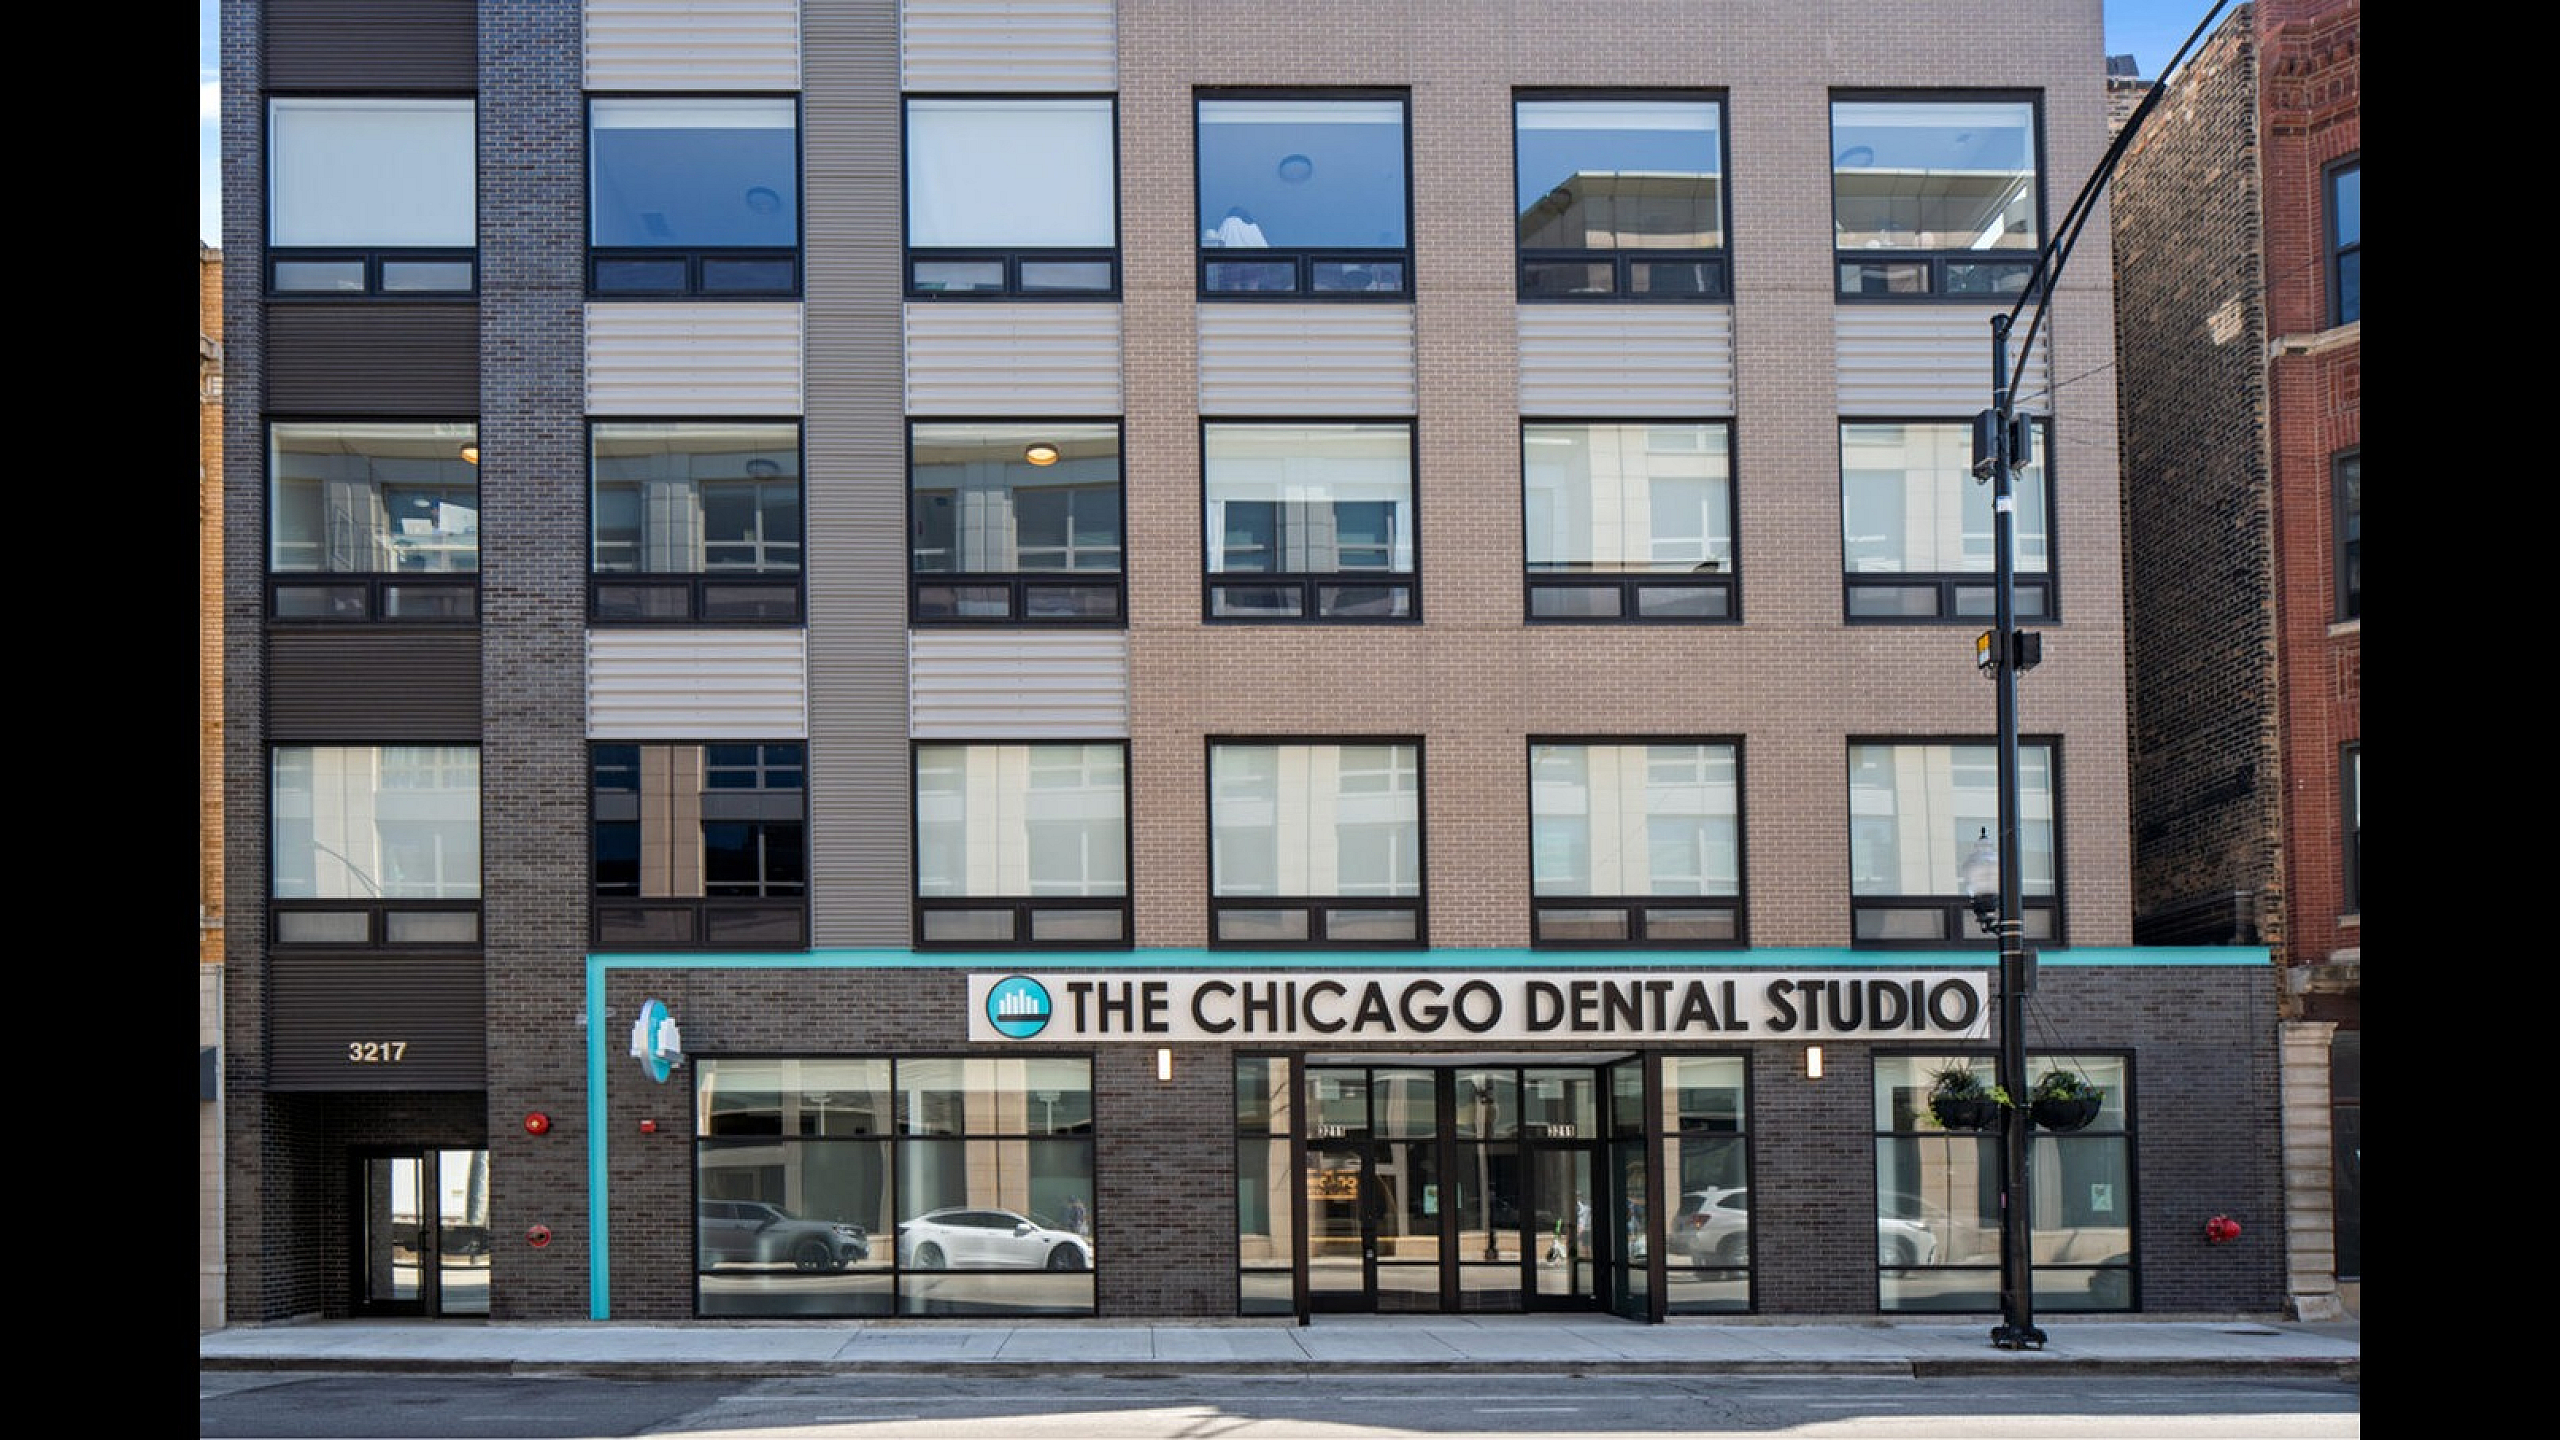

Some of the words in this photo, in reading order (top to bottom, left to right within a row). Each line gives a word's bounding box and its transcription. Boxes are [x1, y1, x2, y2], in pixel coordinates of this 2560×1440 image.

[1066, 980, 1170, 1033] THE
[1191, 979, 1503, 1034] CHICAGO
[1525, 979, 1749, 1031] DENTAL
[1766, 977, 1980, 1032] STUDIO
[349, 1041, 408, 1062] 3217
